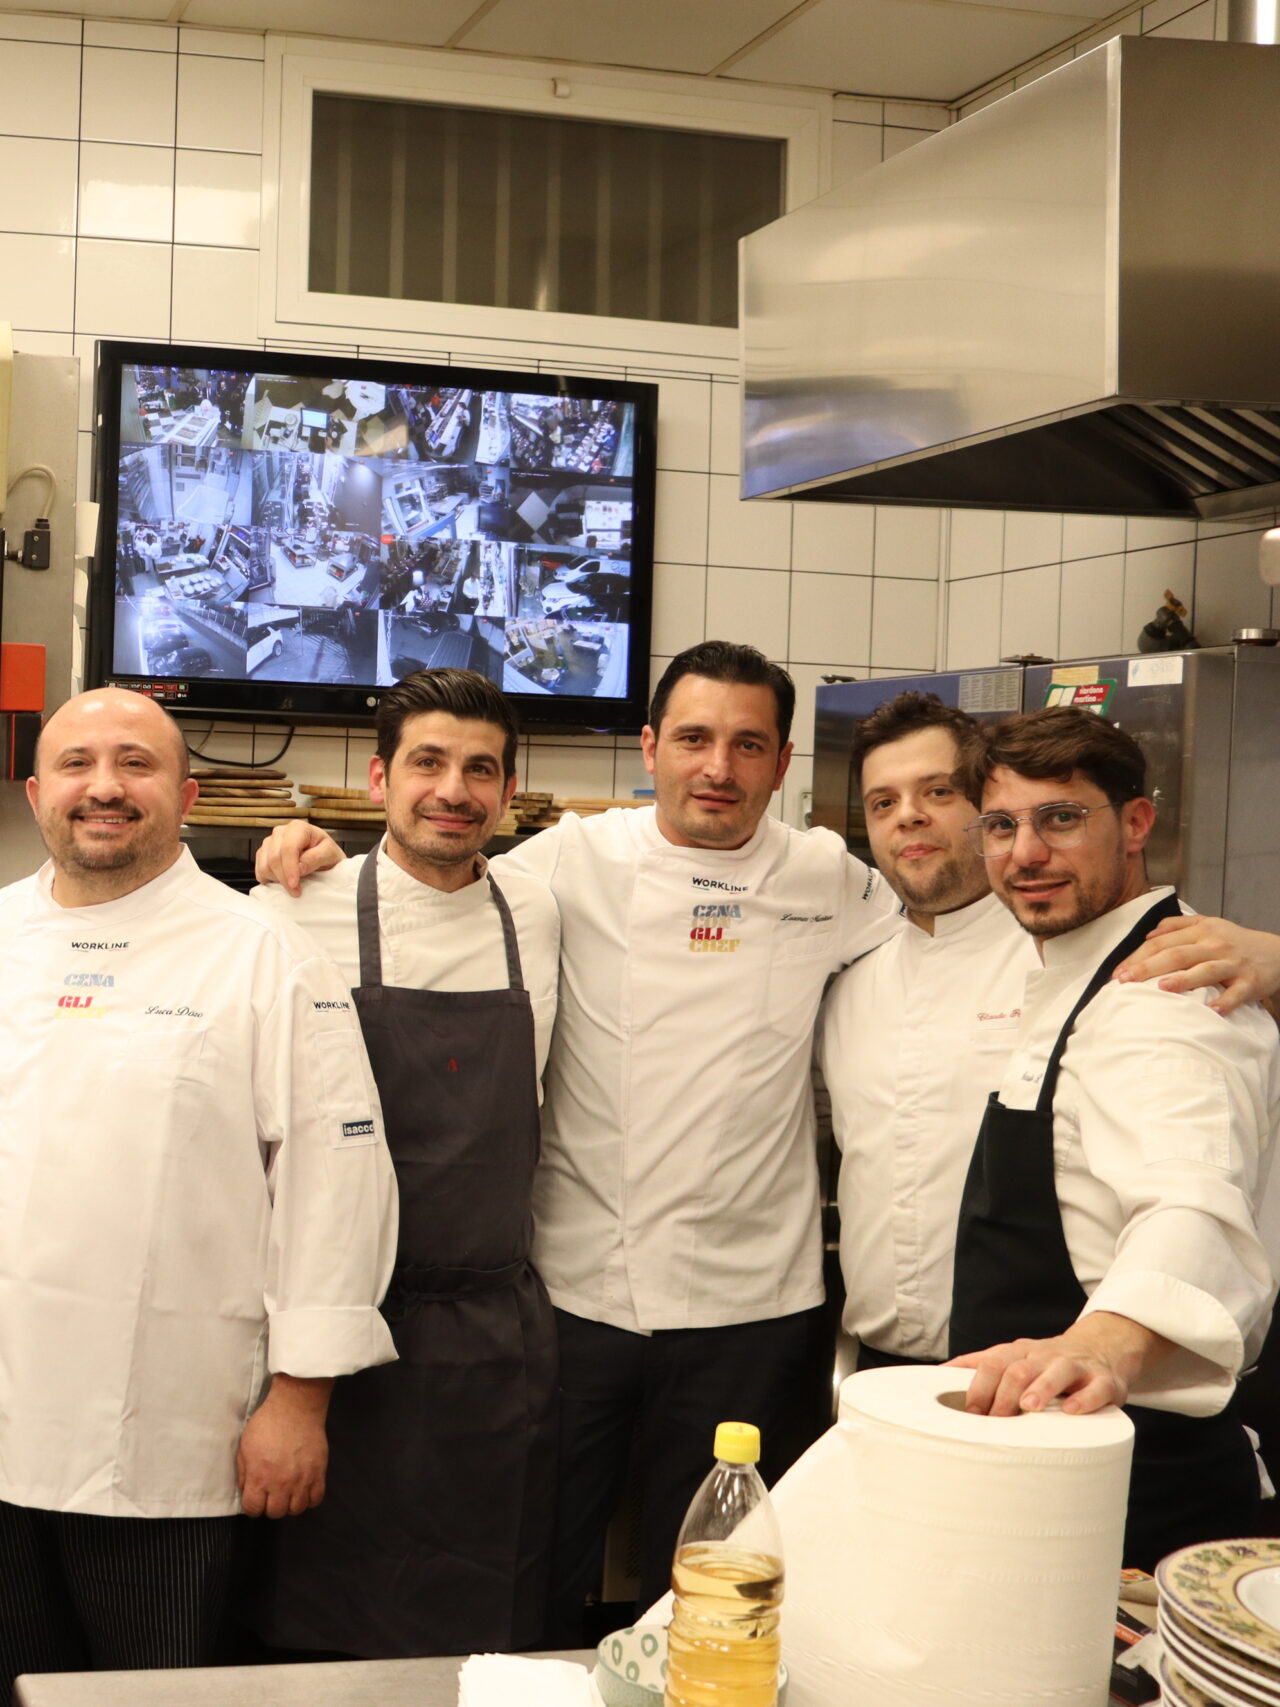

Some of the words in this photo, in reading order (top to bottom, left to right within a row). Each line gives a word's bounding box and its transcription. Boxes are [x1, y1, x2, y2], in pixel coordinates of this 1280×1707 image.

[692, 876, 750, 893] WORKLINE
[71, 941, 130, 951] WORKLINE
[314, 1001, 351, 1010] WORKLINE
